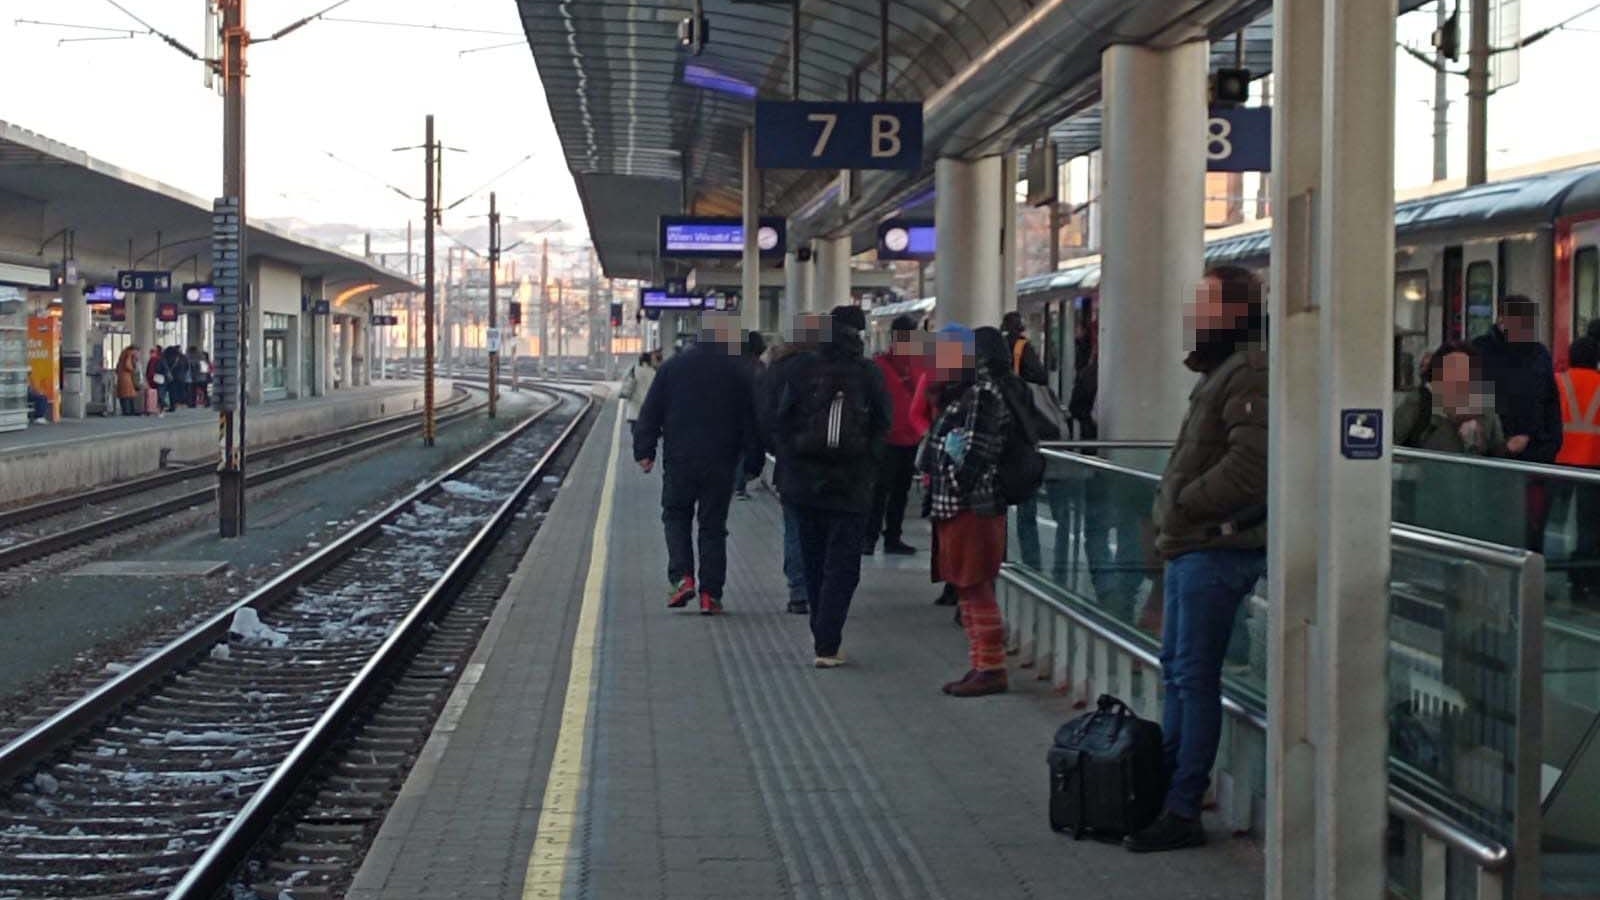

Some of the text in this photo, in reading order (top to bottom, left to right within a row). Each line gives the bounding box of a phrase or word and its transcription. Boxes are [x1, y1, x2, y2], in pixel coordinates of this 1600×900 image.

[807, 113, 901, 158] 7 B
[1206, 117, 1232, 160] 8
[667, 231, 694, 242] Wien
[121, 274, 133, 290] 6
